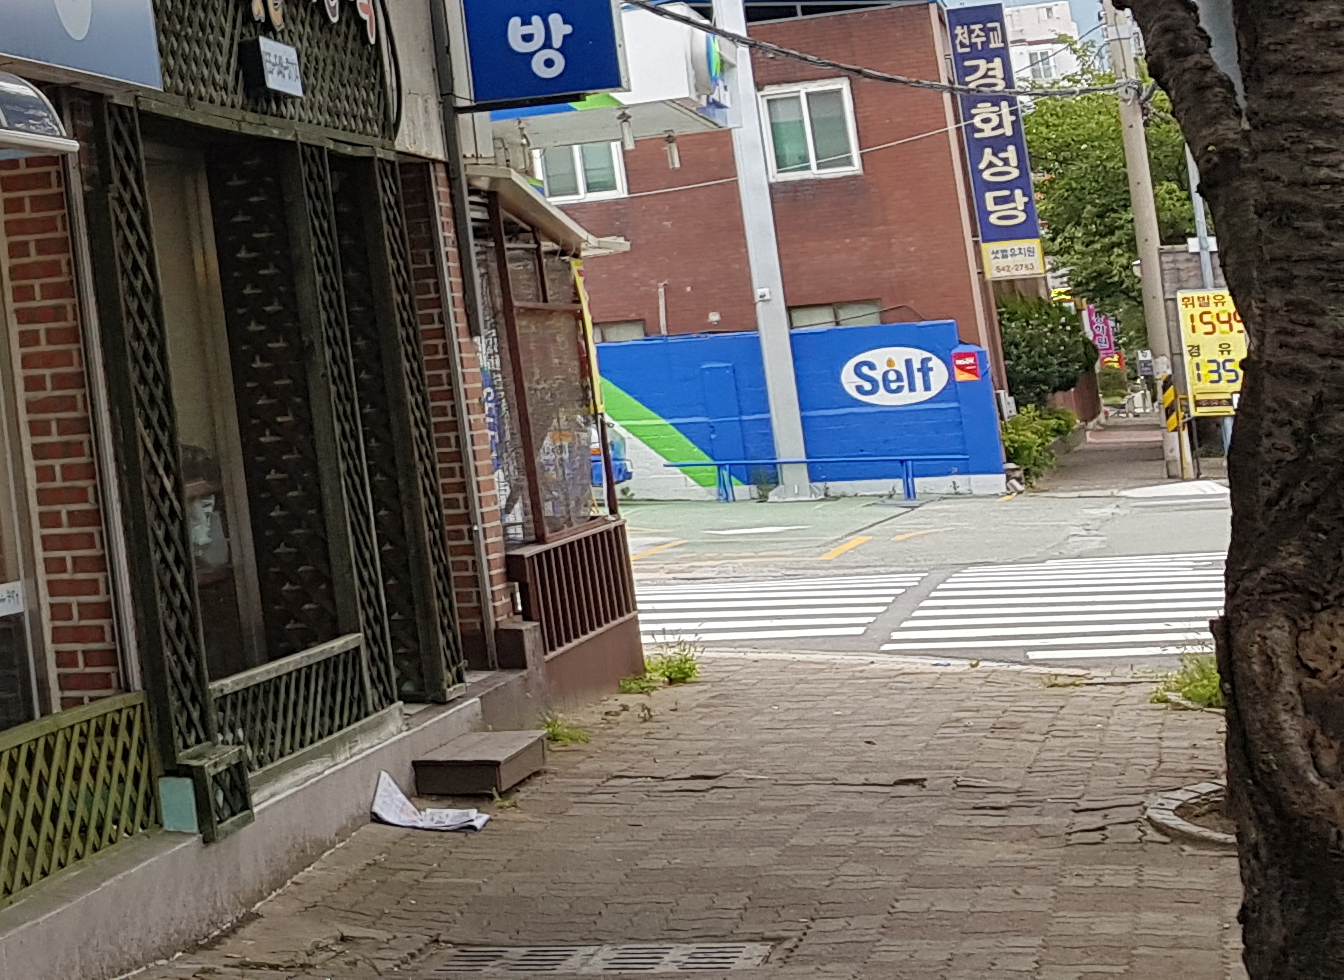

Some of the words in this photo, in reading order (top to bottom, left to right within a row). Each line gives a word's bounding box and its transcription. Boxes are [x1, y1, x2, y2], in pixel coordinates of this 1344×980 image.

[954, 22, 1005, 54] 천주교
[963, 57, 1029, 227] 경화성당
[1181, 295, 1227, 308] 휘발유
[853, 357, 934, 396] Self
[1196, 359, 1240, 384] 135
